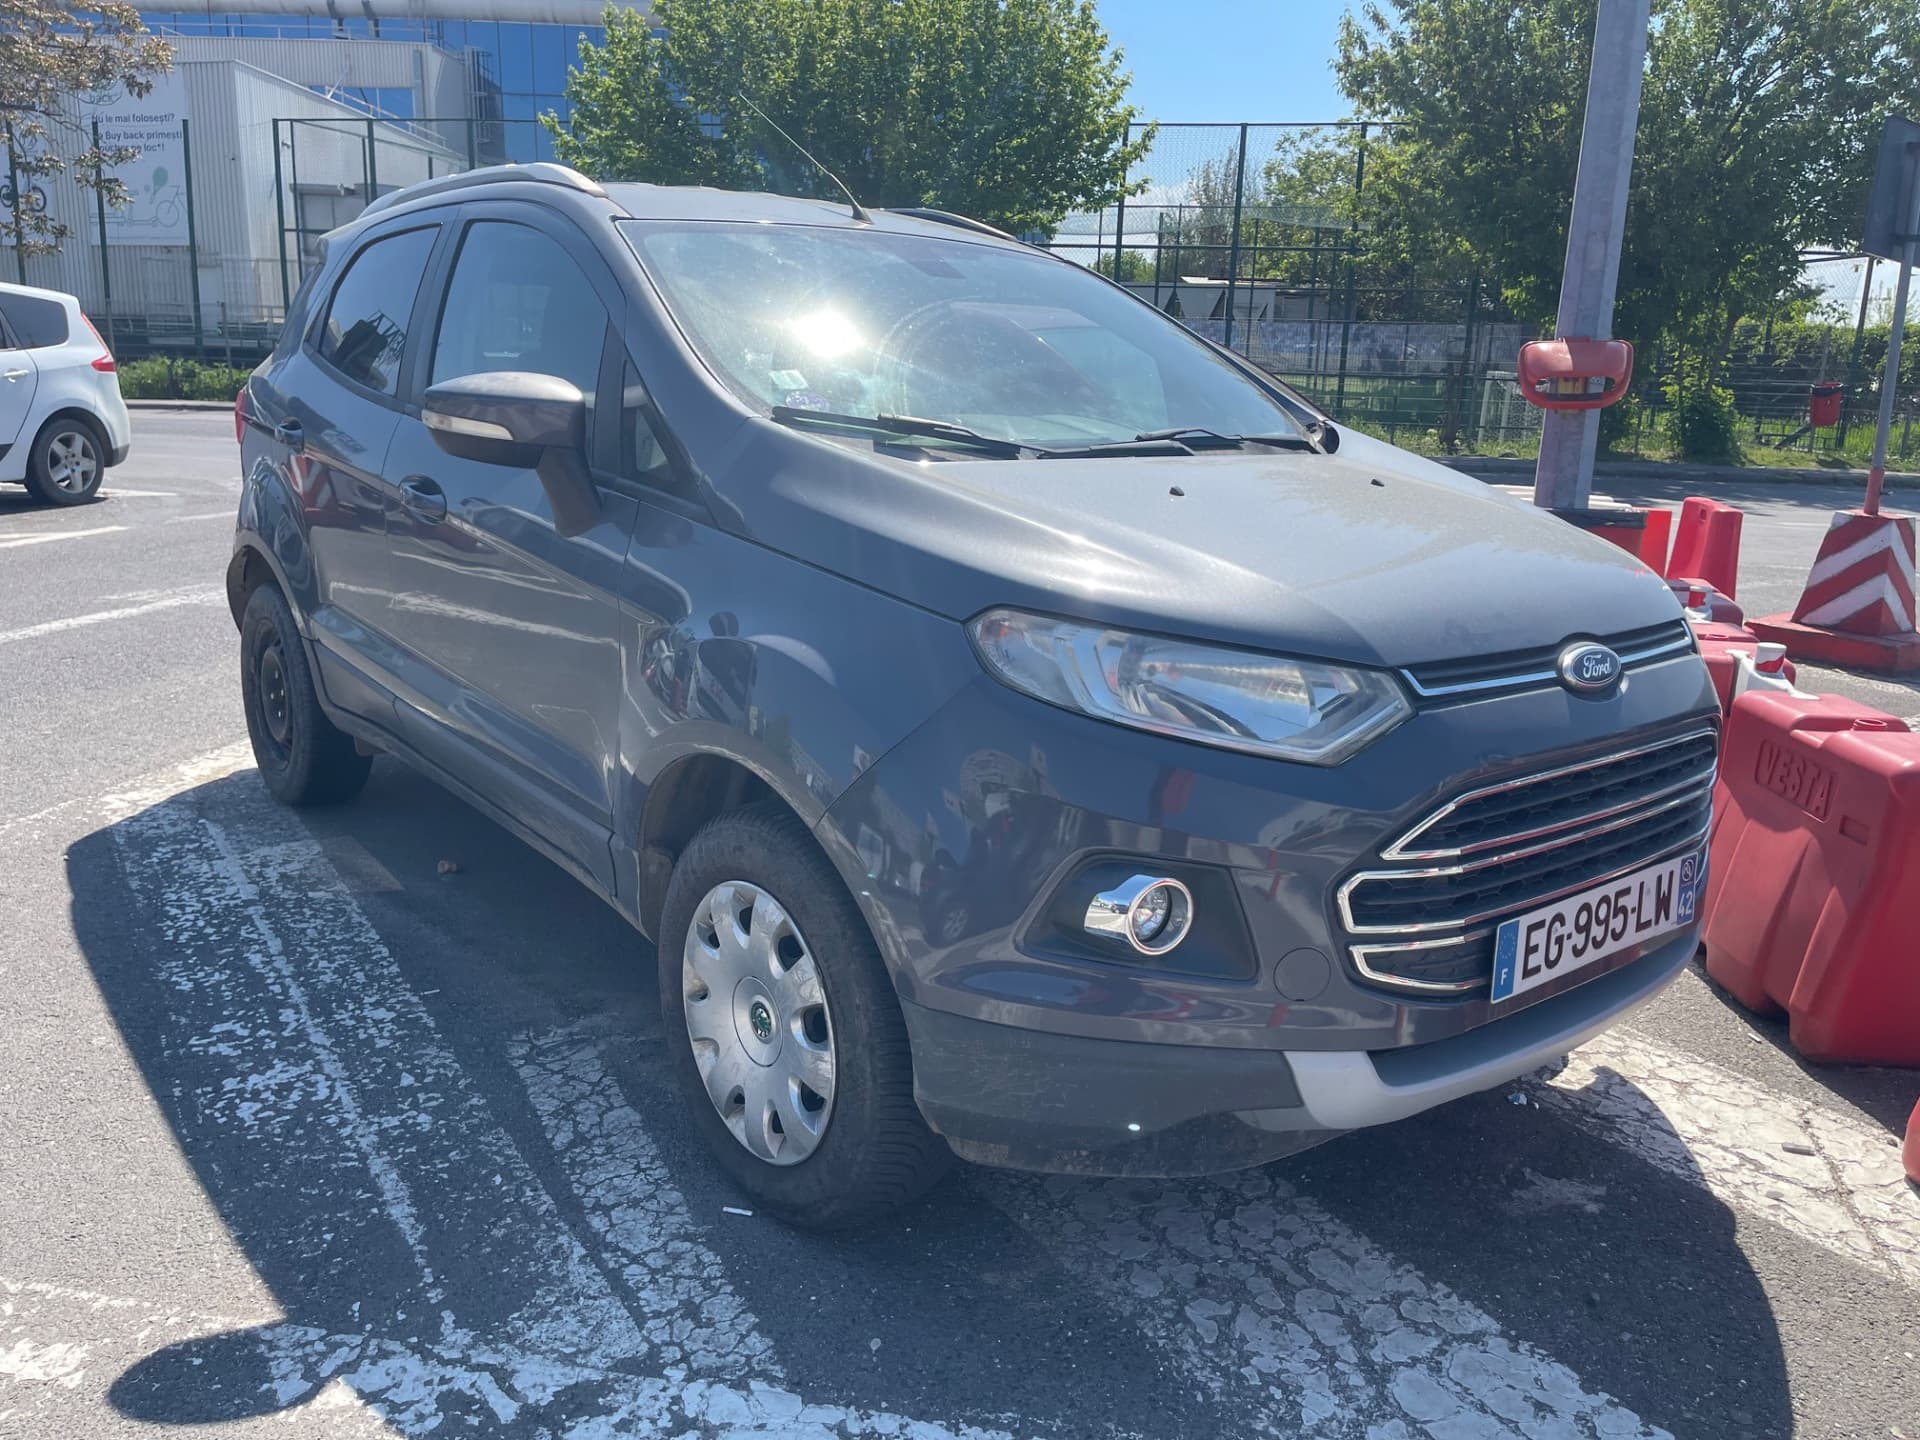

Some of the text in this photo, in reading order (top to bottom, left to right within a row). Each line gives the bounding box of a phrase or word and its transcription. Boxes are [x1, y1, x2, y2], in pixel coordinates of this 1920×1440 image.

[105, 114, 113, 122] le
[115, 114, 131, 122] mai
[105, 131, 121, 141] Buy
[123, 130, 144, 140] back
[98, 143, 129, 152] oucher
[1583, 654, 1612, 678] Ford
[1763, 744, 1834, 816] VESTA
[1500, 869, 1693, 986] F EG-995-LW 42
